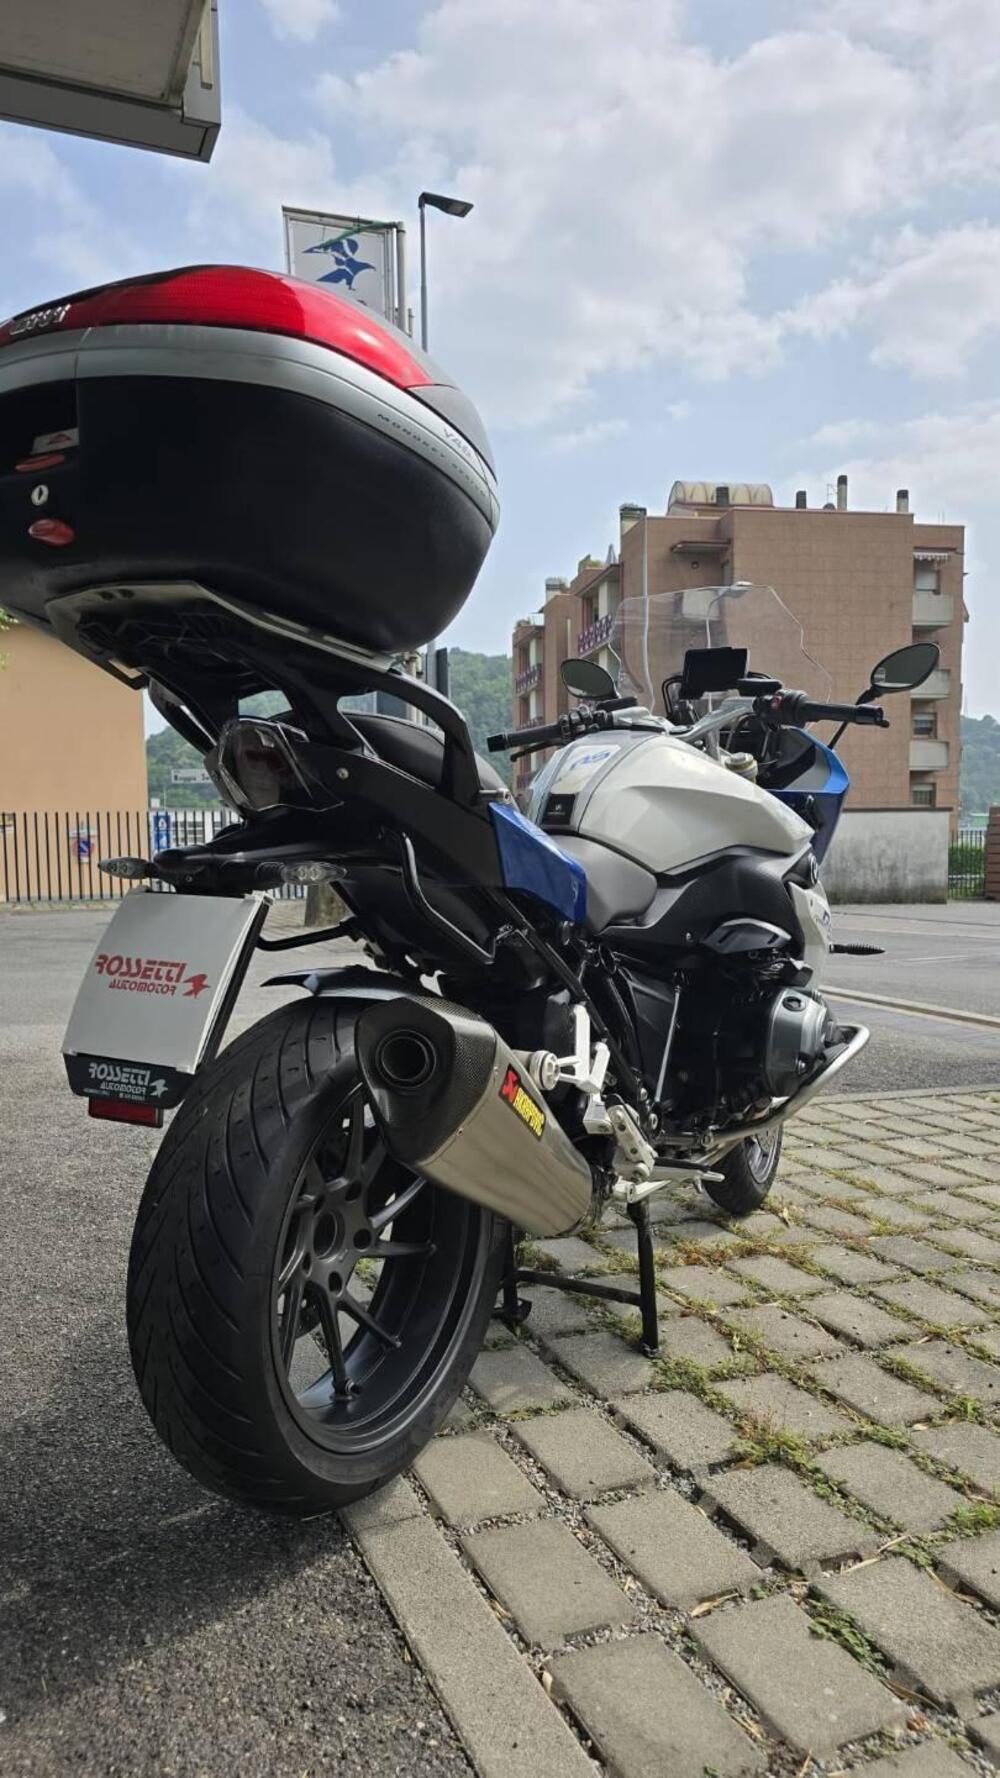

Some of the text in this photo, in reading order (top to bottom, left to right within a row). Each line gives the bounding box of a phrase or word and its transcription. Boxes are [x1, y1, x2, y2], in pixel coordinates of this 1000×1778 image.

[95, 954, 187, 983] ROSSETTI
[108, 979, 177, 996] AUTOMOTOR
[88, 1062, 151, 1086] ROSSETTI
